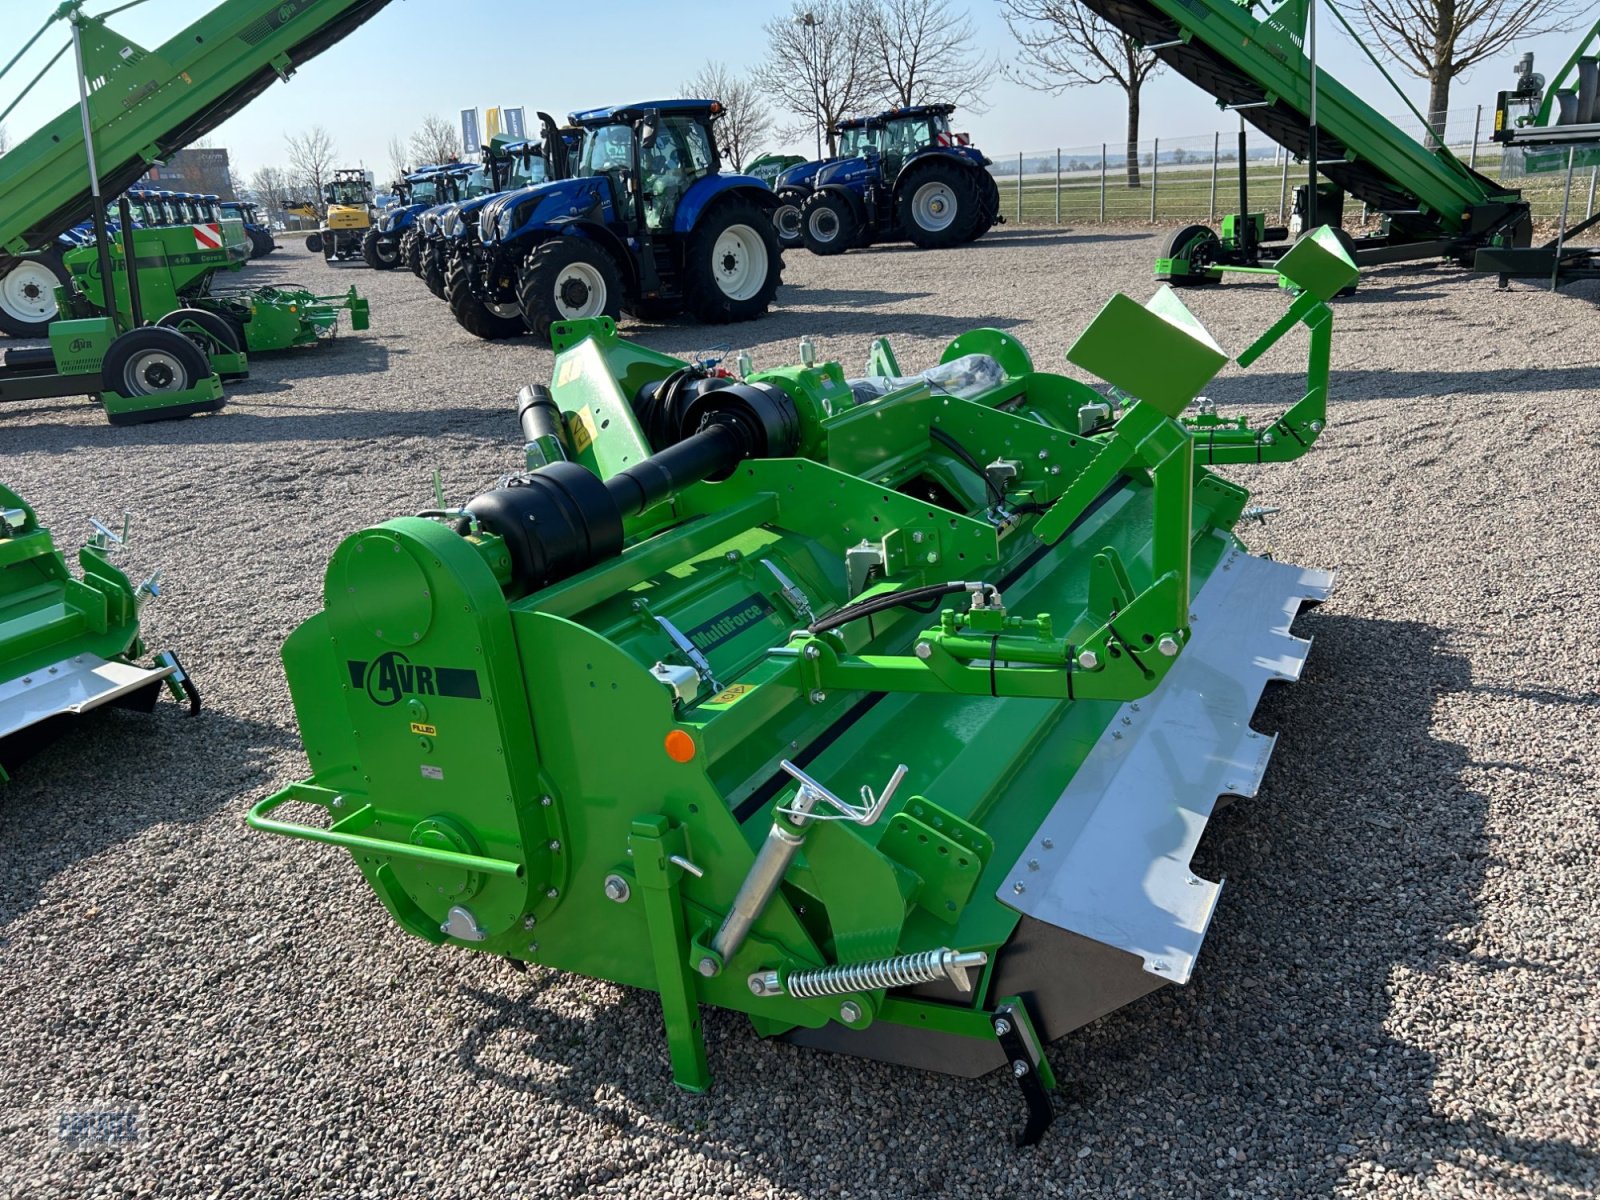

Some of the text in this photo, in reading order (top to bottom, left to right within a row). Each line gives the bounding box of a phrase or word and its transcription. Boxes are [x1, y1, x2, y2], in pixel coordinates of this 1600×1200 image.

[69, 338, 92, 353] AVR
[690, 604, 763, 650] MultiForce
[367, 651, 436, 706] AVR
[412, 723, 435, 735] FILLED
